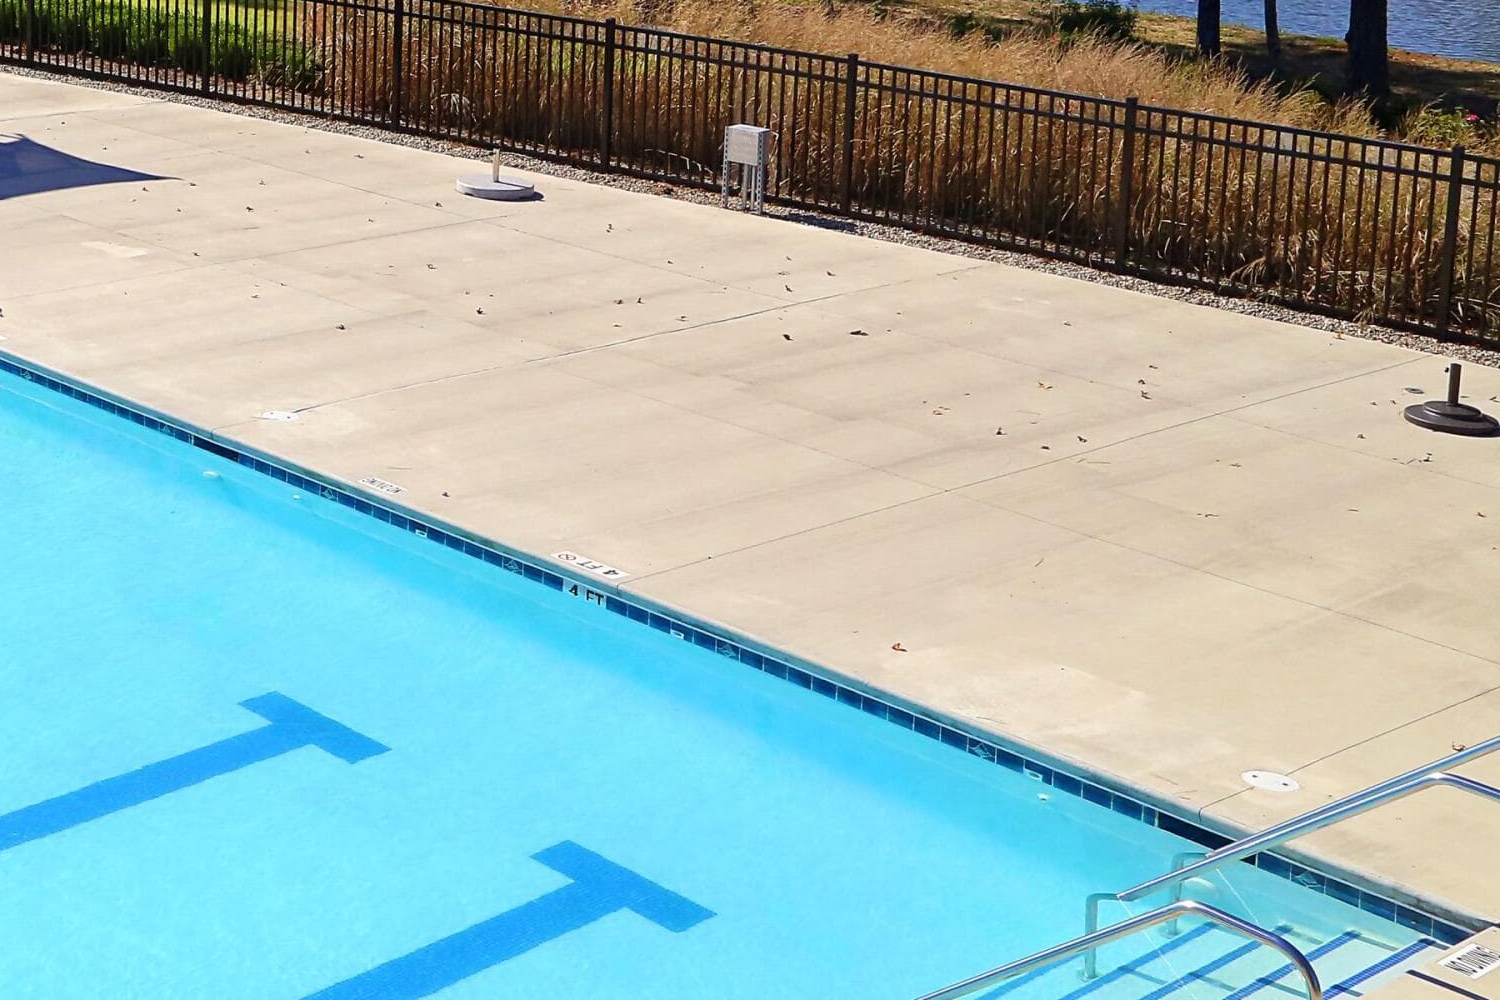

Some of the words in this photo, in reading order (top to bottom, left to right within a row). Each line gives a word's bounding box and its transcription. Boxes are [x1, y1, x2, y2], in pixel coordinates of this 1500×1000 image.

[576, 560, 603, 570] FT
[568, 584, 579, 597] 4
[586, 589, 605, 606] FT
